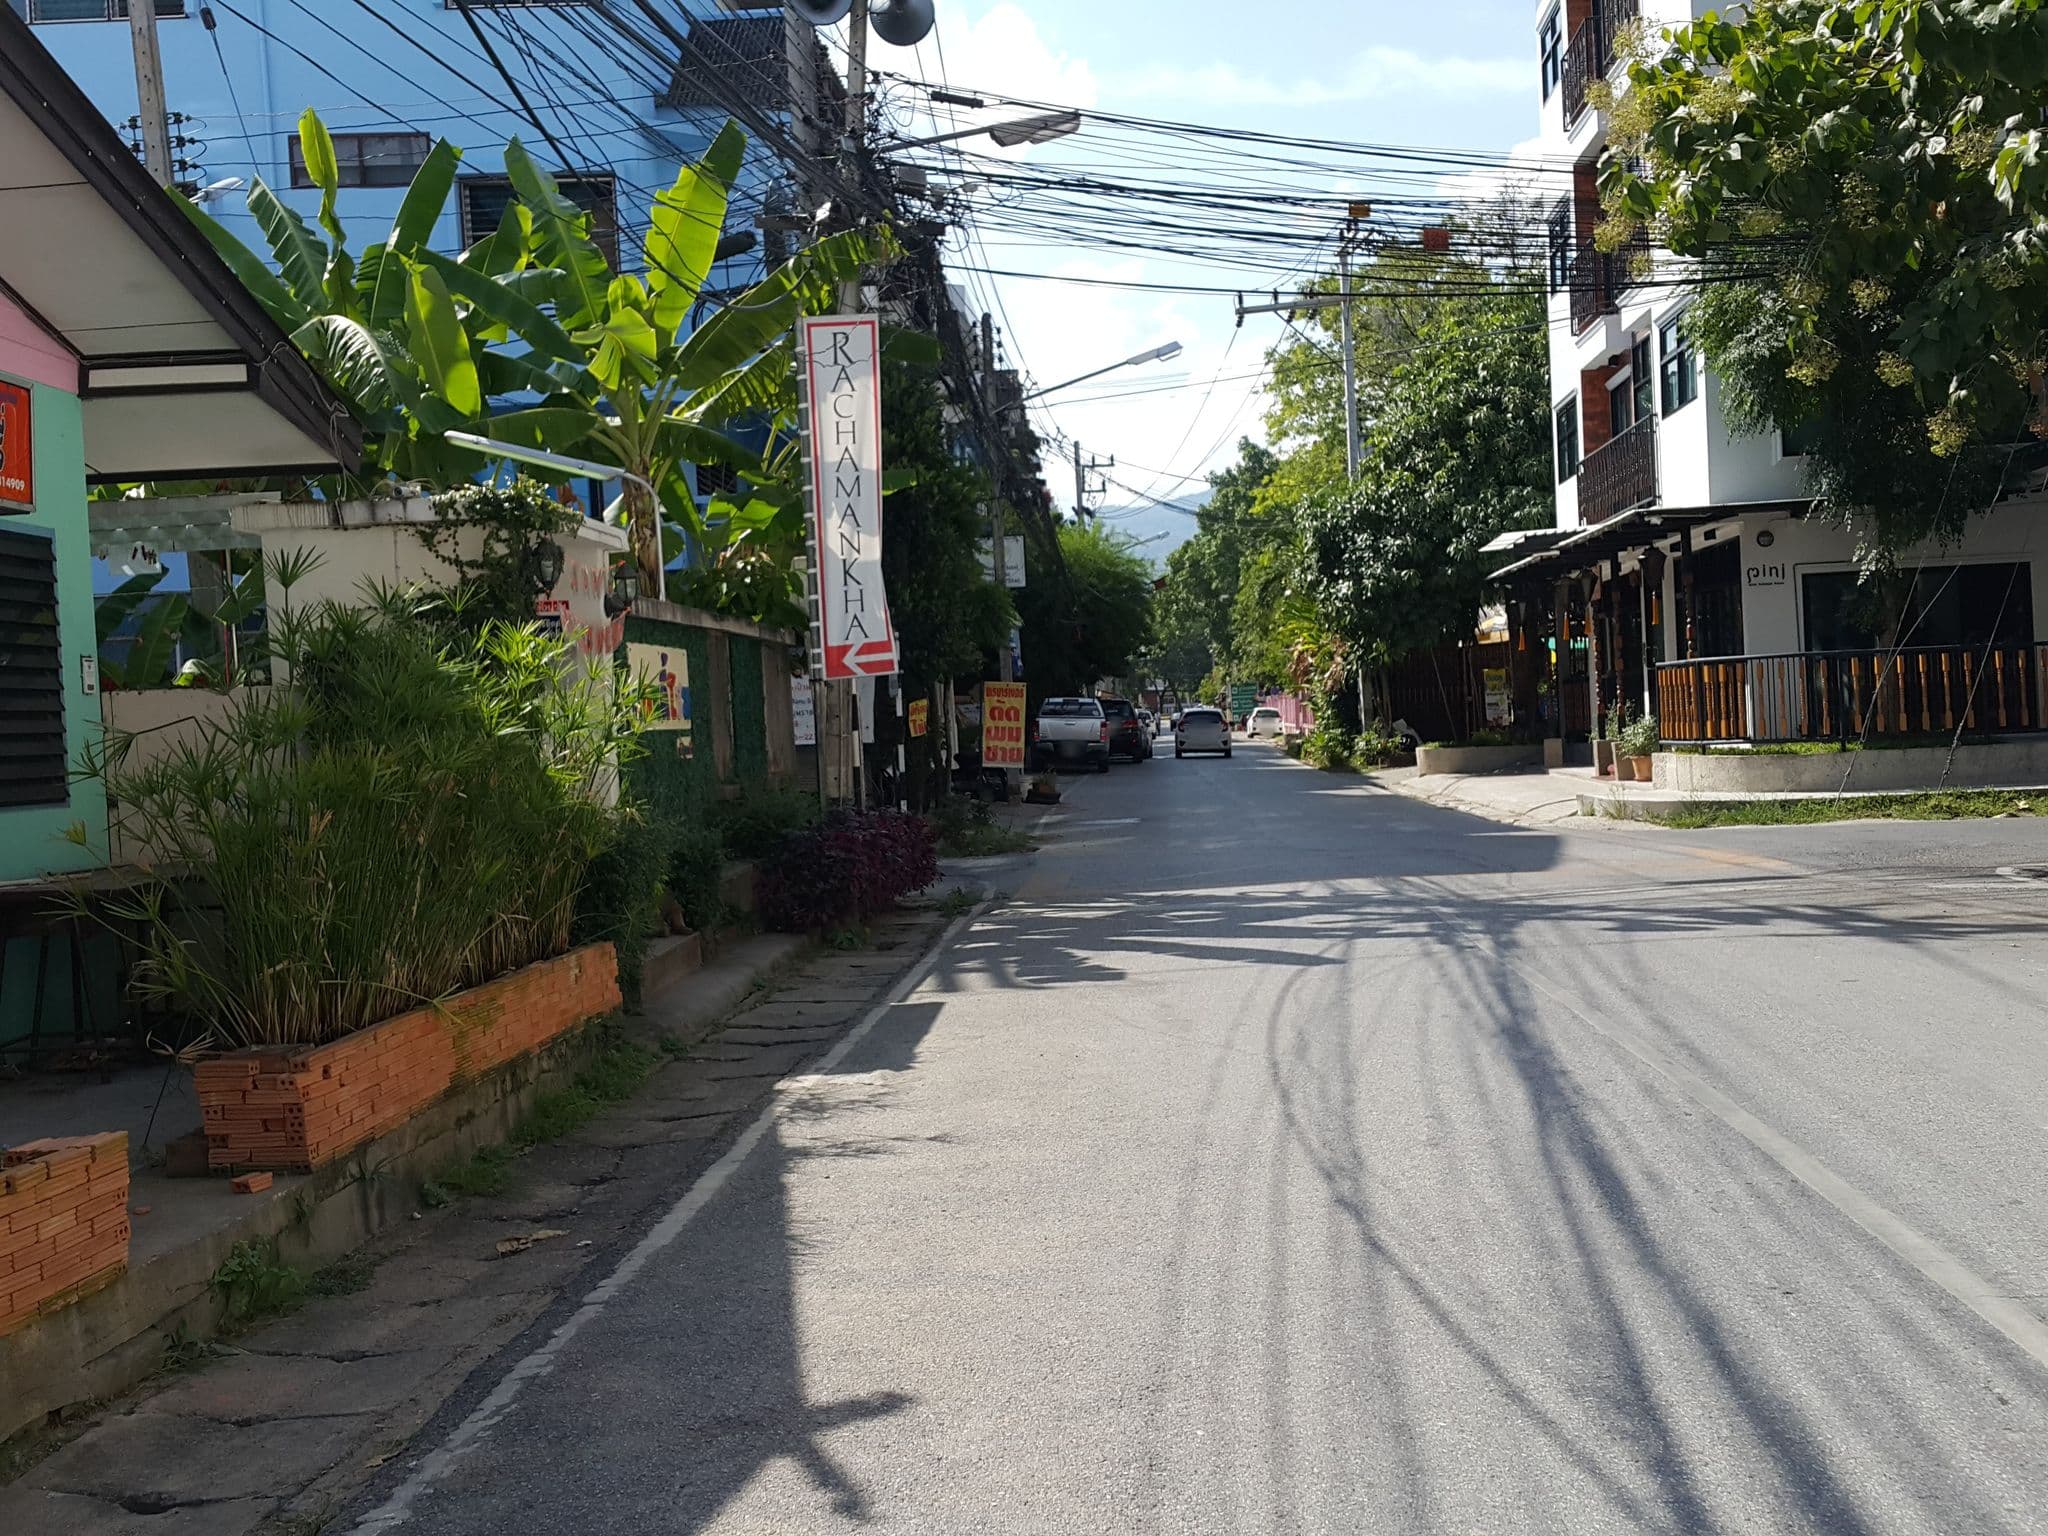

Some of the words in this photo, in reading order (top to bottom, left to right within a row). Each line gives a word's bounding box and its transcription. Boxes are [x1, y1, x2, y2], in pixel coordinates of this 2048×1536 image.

[0, 475, 25, 492] 14909
[831, 331, 870, 641] RACHAMANKHA
[986, 726, 1022, 743] ผม
